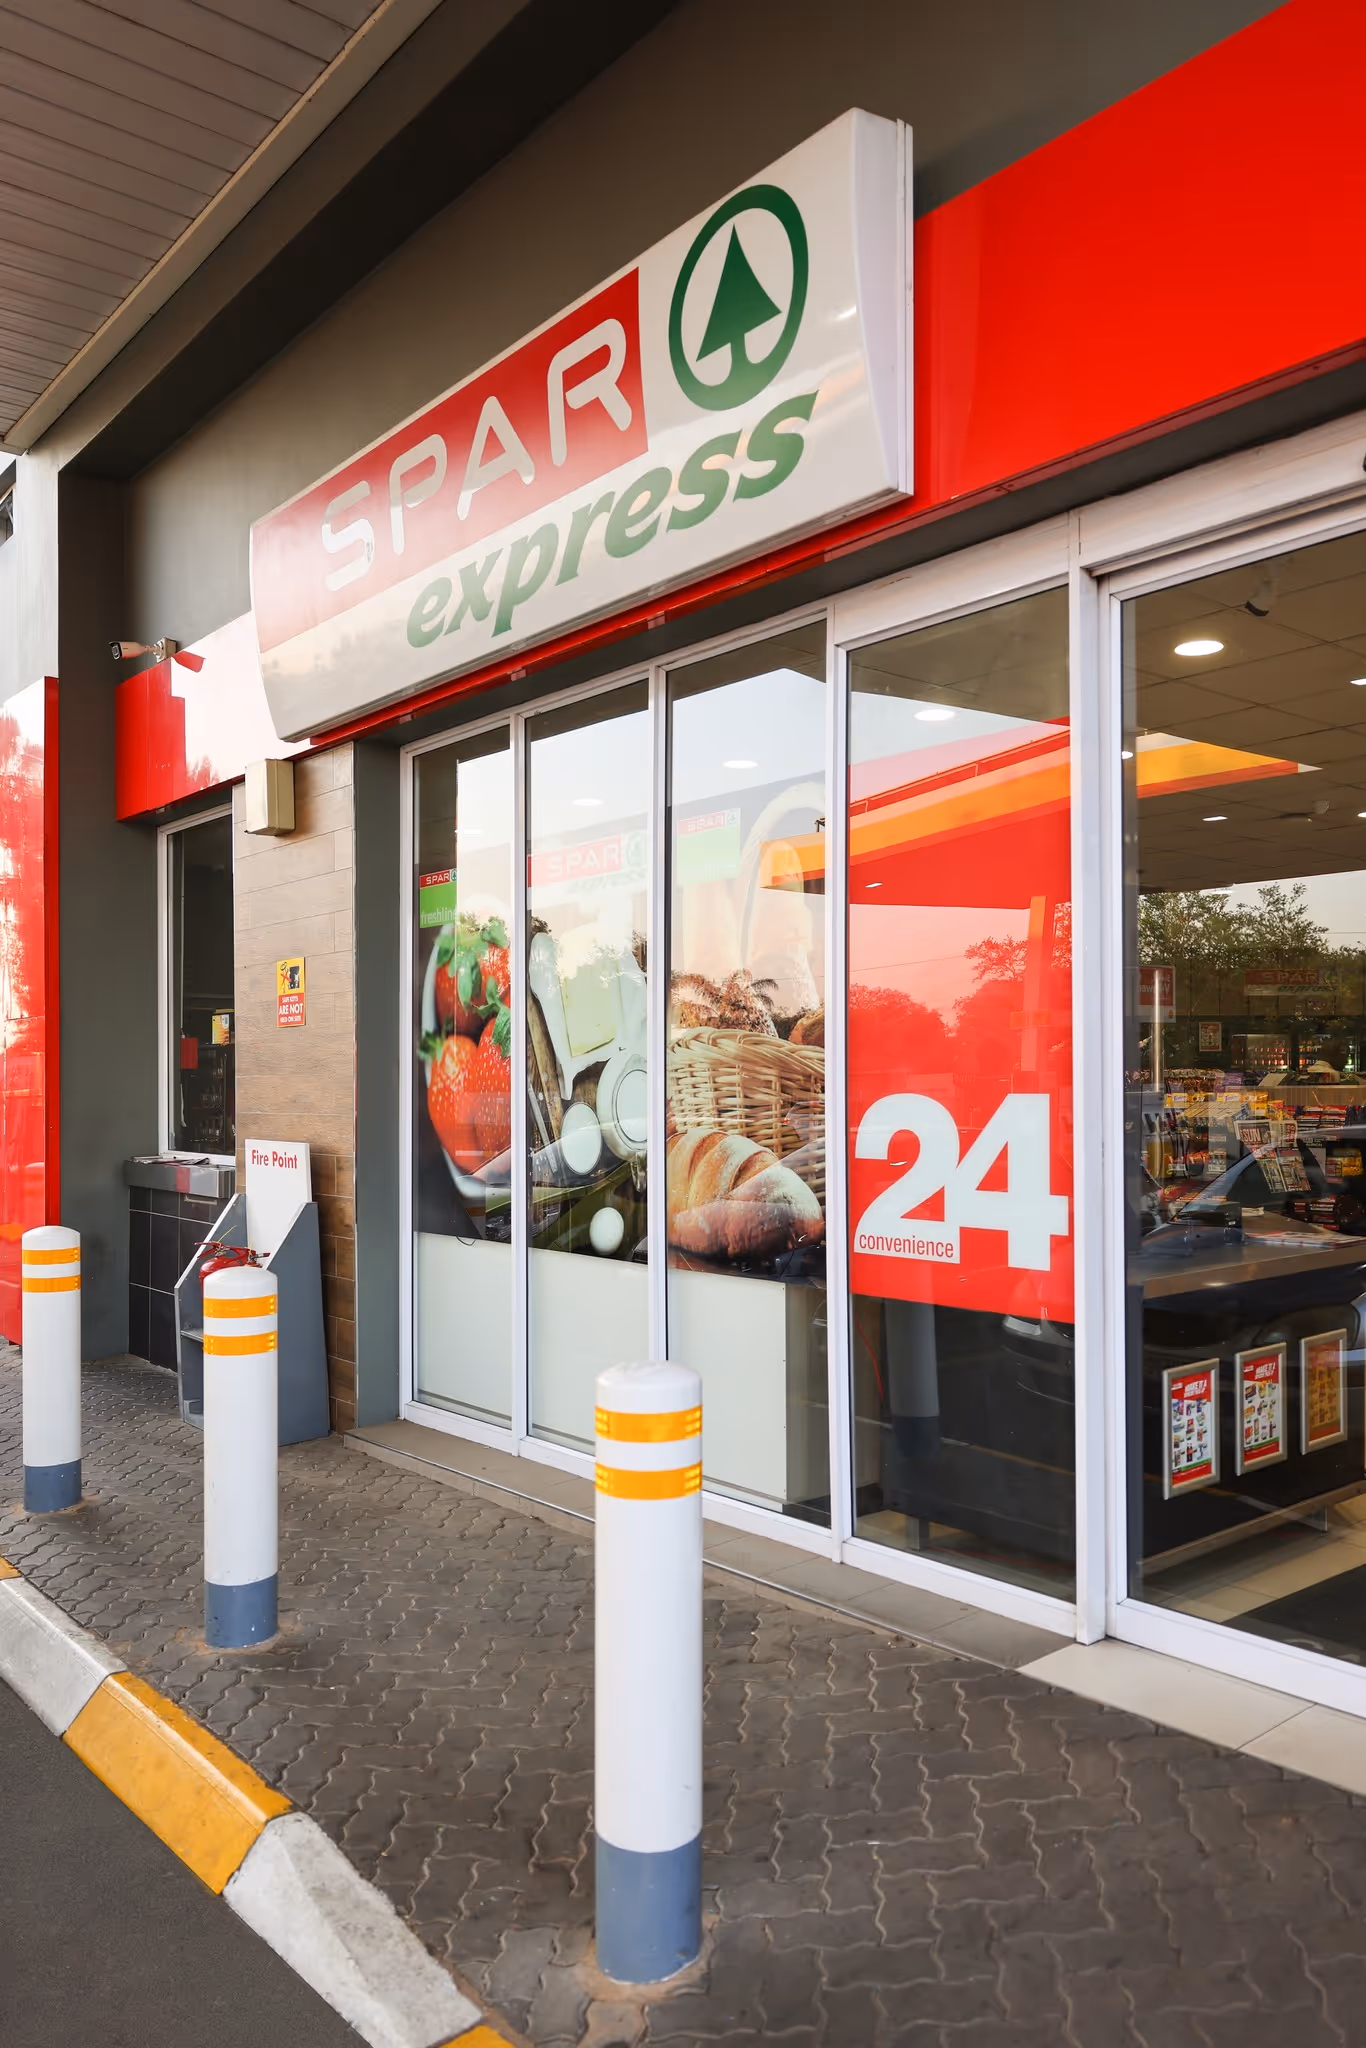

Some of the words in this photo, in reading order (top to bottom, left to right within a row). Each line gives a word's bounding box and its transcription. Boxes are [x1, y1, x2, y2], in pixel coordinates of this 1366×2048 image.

[321, 317, 633, 592] SPAR
[406, 389, 820, 648] express
[425, 872, 451, 885] SPAR
[279, 1004, 289, 1015] ARE
[289, 1003, 303, 1014] NOT
[251, 1149, 269, 1166] Fire
[272, 1151, 298, 1169] Point
[853, 1092, 1069, 1272] 24
[859, 1234, 954, 1258] convenience
